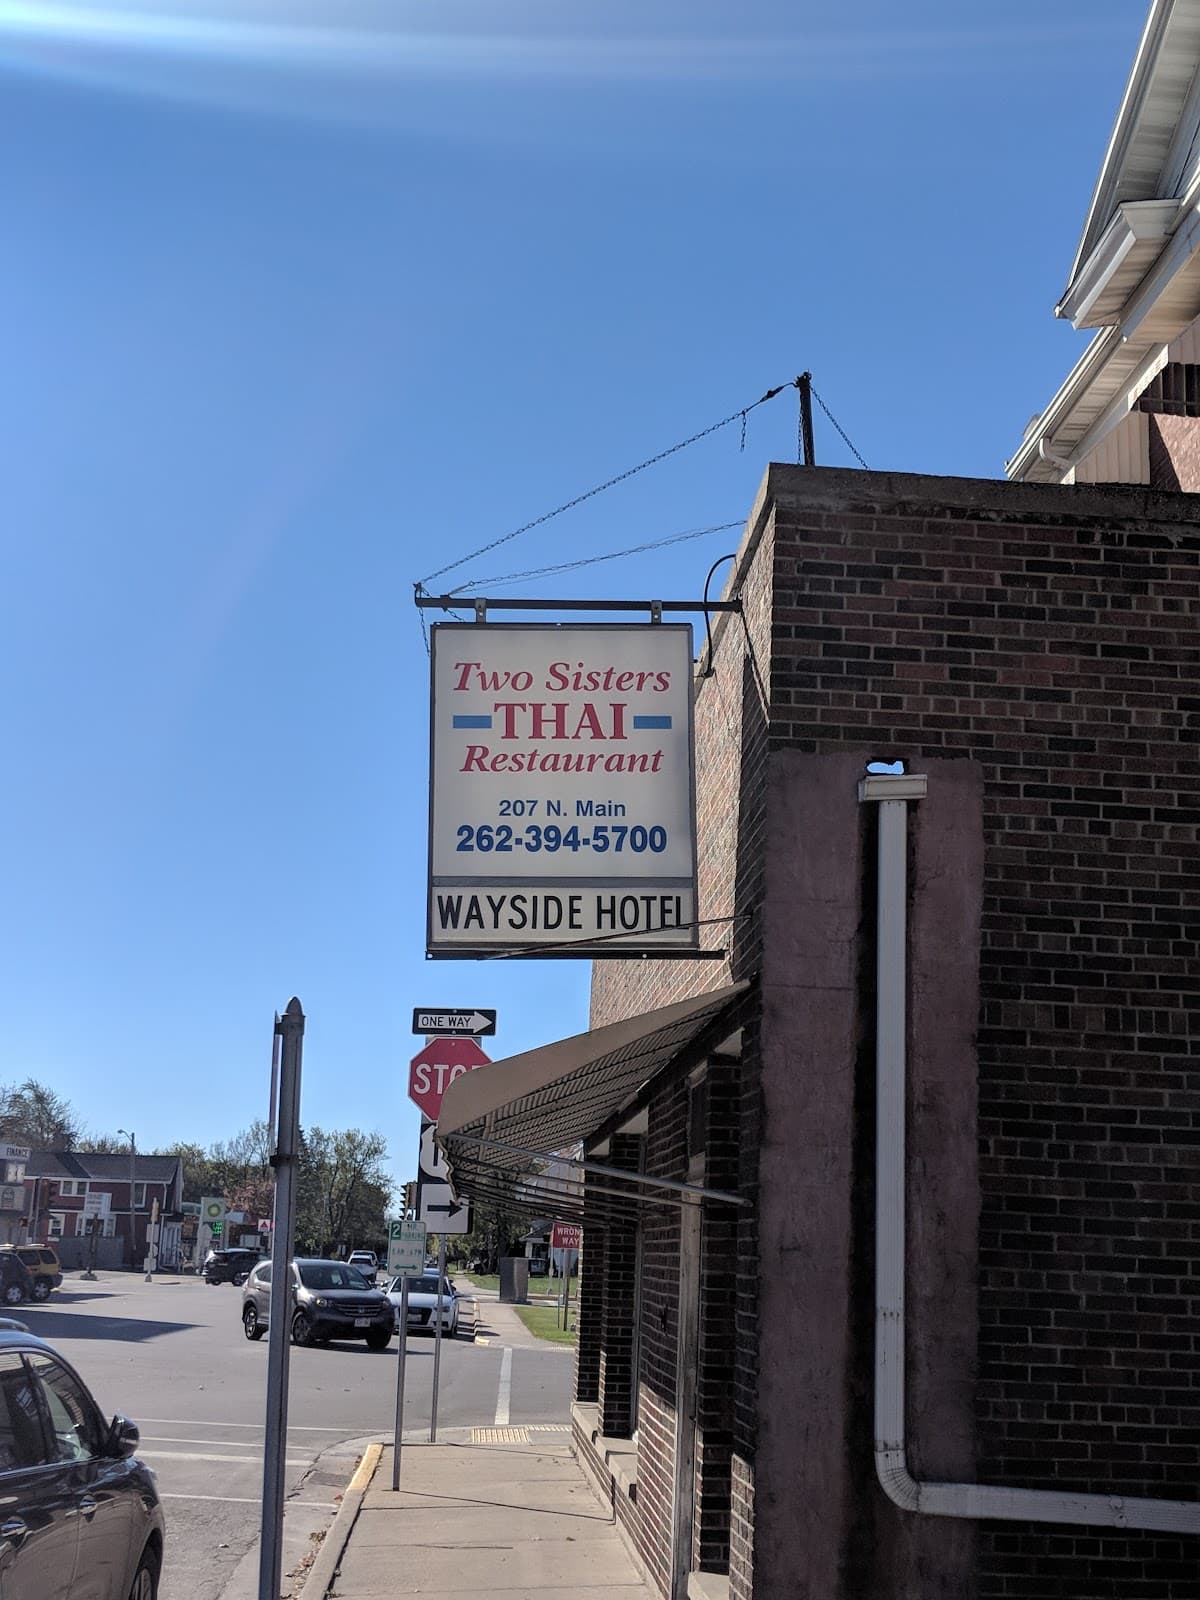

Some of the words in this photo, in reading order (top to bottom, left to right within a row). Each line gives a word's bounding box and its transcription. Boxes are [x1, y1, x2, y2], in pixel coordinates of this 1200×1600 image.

[453, 662, 533, 692] Two
[545, 662, 671, 692] Sisters
[493, 703, 628, 740] THAI
[459, 745, 664, 772] Restaurant
[498, 800, 538, 817] 207
[546, 800, 568, 817] N.
[576, 800, 626, 817] Main
[437, 895, 583, 930] WAYSIDE
[596, 895, 690, 930] HOTEL
[421, 1016, 444, 1027] ONE
[448, 1016, 471, 1028] WAY
[413, 1063, 482, 1095] ST
[391, 1223, 401, 1238] 2
[557, 1226, 580, 1236] WRON
[562, 1236, 580, 1246] WAY
